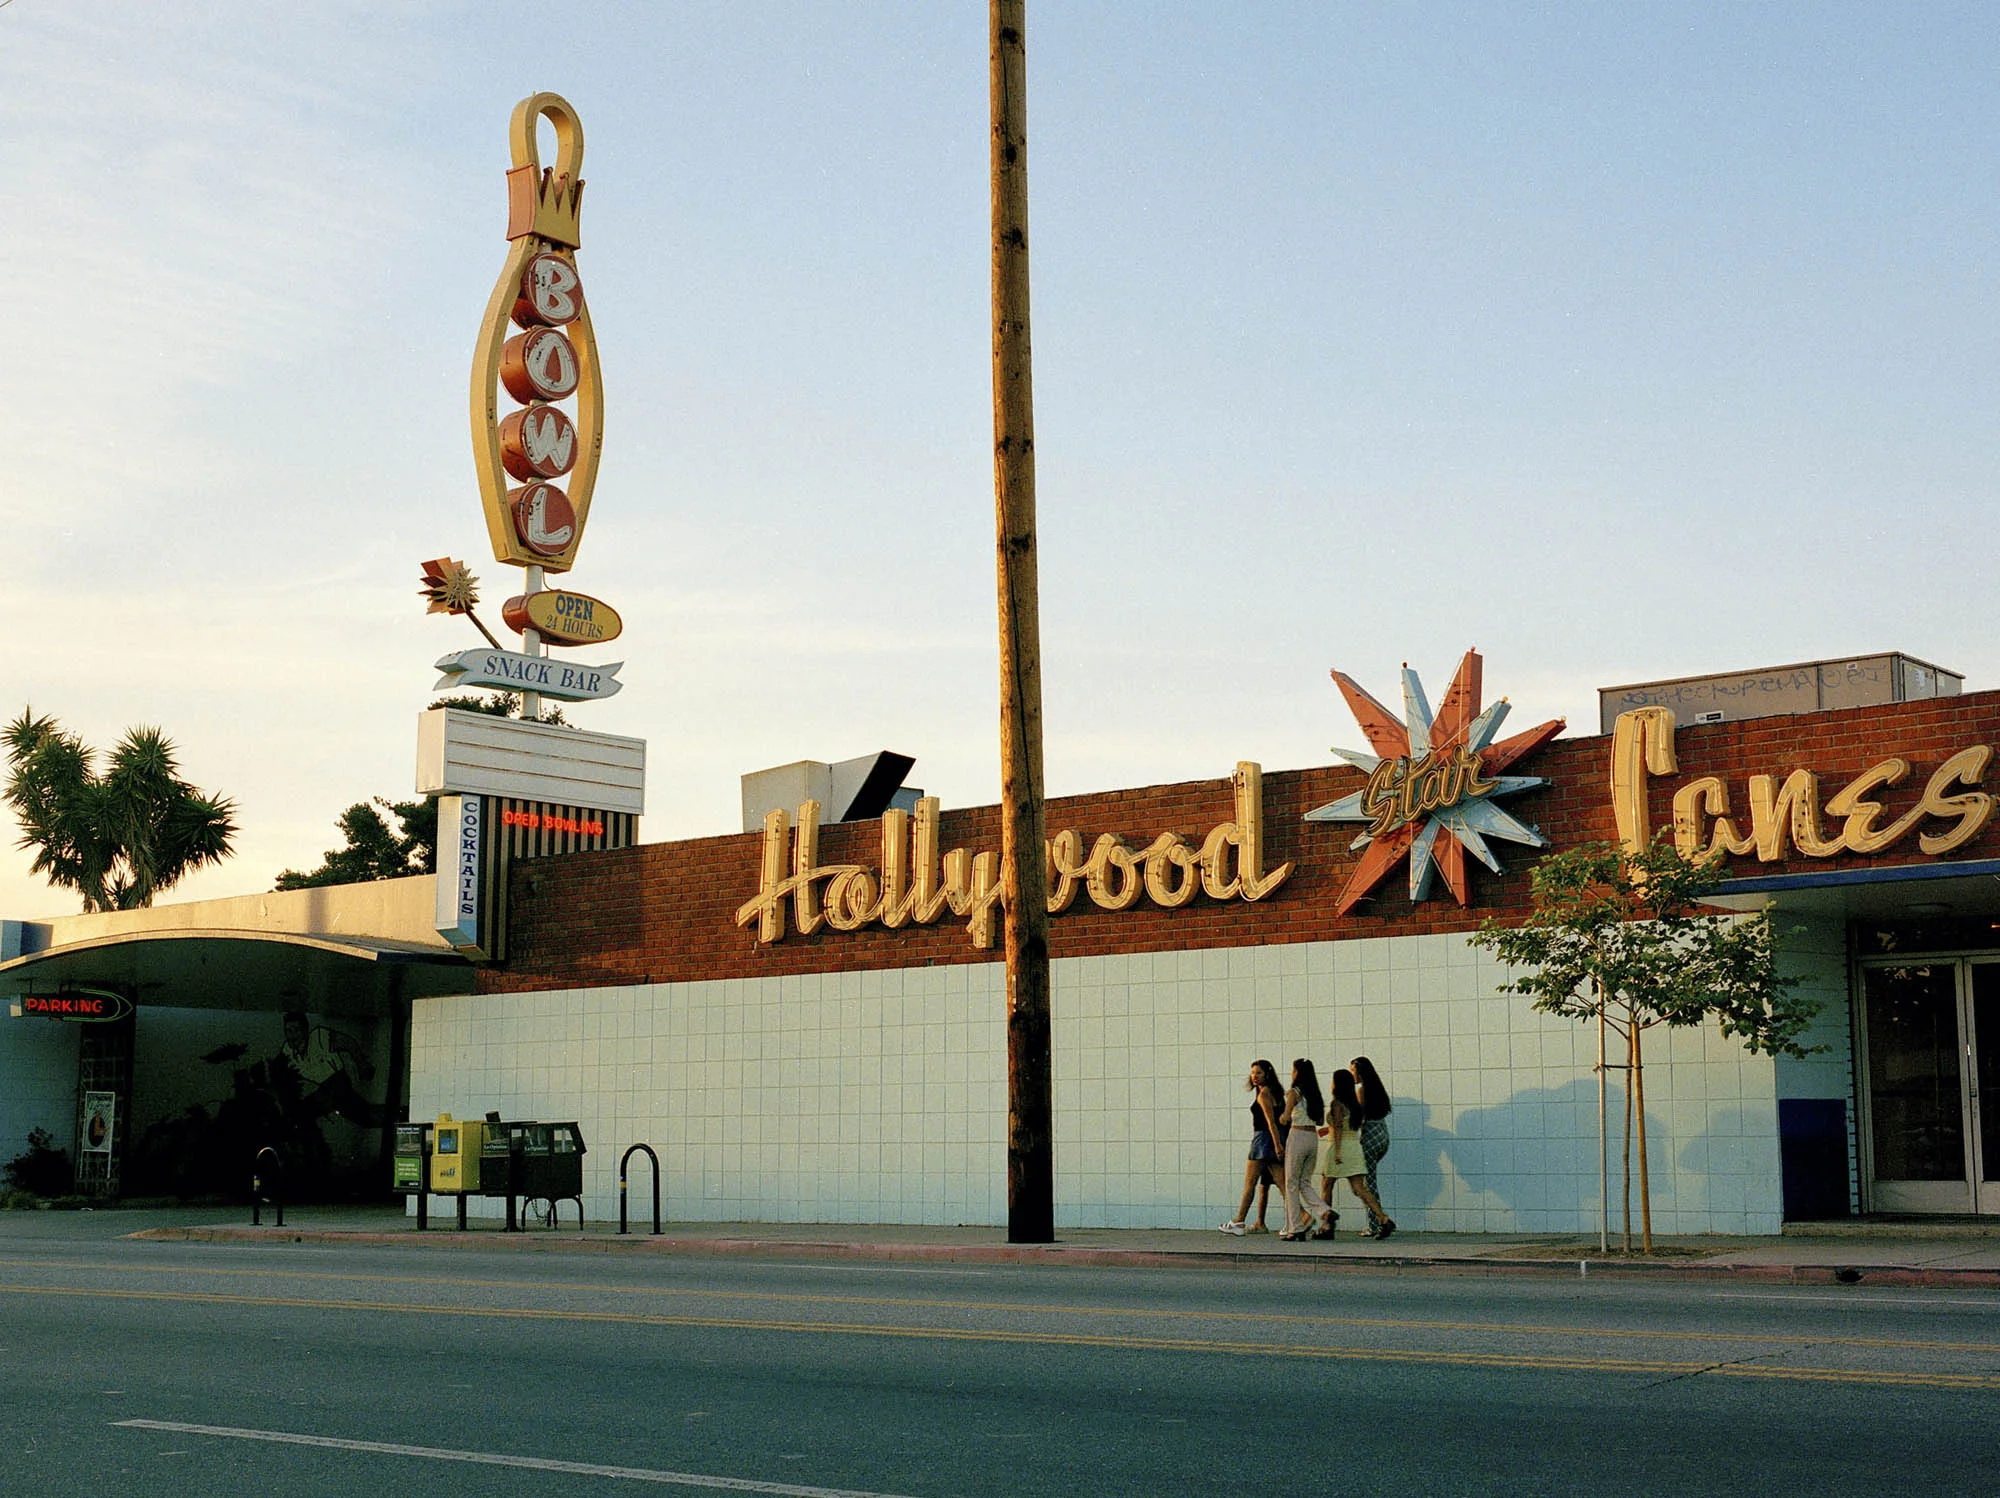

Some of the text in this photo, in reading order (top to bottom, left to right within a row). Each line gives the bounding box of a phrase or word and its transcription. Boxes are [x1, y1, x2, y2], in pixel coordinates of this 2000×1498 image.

[525, 257, 579, 544] BOWL
[555, 594, 594, 621] OPEN
[545, 614, 604, 639] 24 HOURS
[484, 655, 601, 692] SNACK BAR
[1360, 744, 1500, 837] Star
[1609, 705, 1997, 900] Lanes
[503, 810, 605, 836] OPEN BOWLING
[461, 801, 478, 915] COCKTAILS
[26, 997, 103, 1013] PARKING
